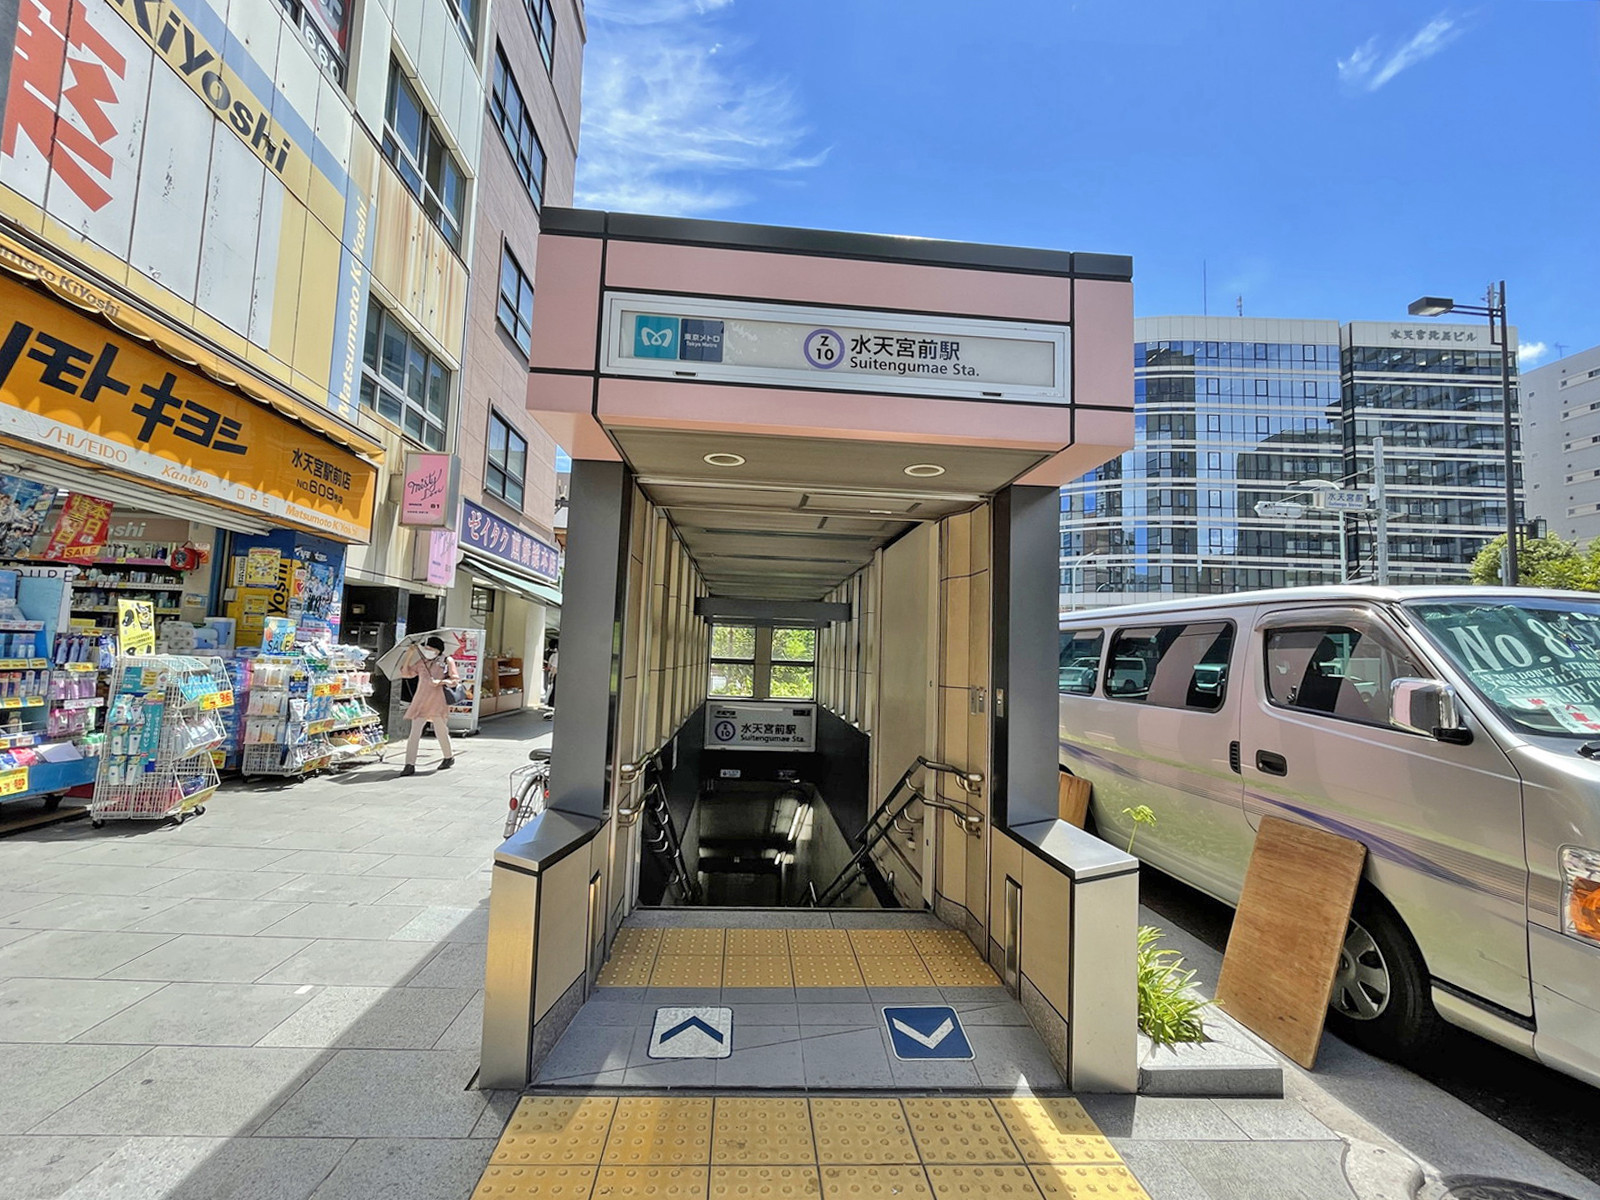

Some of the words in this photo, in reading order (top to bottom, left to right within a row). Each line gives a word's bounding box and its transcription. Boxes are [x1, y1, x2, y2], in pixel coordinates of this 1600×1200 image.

[684, 332, 720, 343] 東京メトロ
[820, 335, 830, 347] Z
[816, 348, 834, 361] 10
[850, 334, 960, 362] 水天宮前駅
[850, 356, 948, 376] Suitengumae
[953, 363, 980, 377] Sta.
[38, 426, 128, 464] SHISEIDO
[161, 465, 209, 490] Kanebo
[291, 448, 352, 491] 水天宮駅前店
[741, 723, 797, 735] 水天宮前駅
